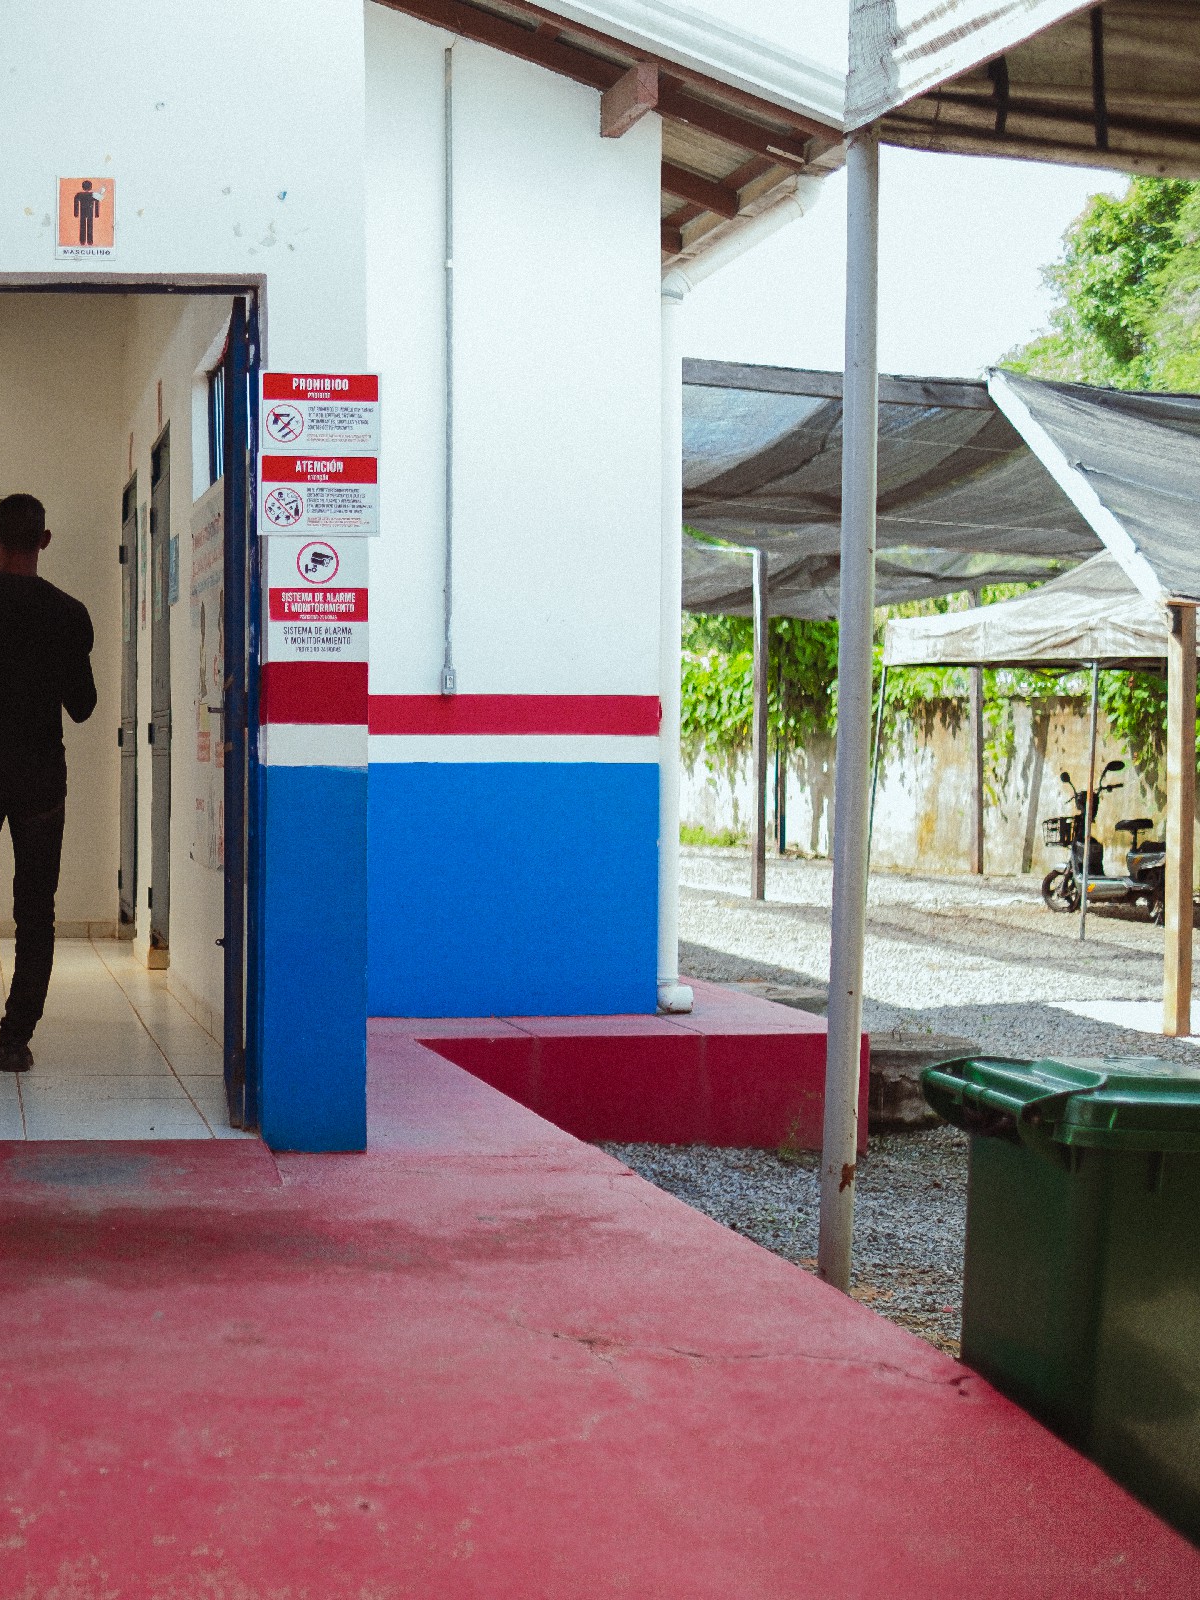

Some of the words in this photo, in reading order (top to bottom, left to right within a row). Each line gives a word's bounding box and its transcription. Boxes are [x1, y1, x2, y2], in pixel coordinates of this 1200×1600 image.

[292, 377, 349, 391] PROHIBIDO
[295, 459, 344, 473] ATENCIÓN
[281, 591, 313, 602] SISTEMA
[315, 592, 324, 602] DE
[326, 592, 356, 603] ALARME
[284, 602, 289, 613] E
[291, 603, 355, 613] MONITORAMENTO
[283, 626, 313, 636] SISTEMA
[314, 627, 323, 635] DE
[324, 626, 353, 636] ALARMA
[284, 636, 289, 645] Y
[290, 636, 351, 645] MONITORAMIENTO
